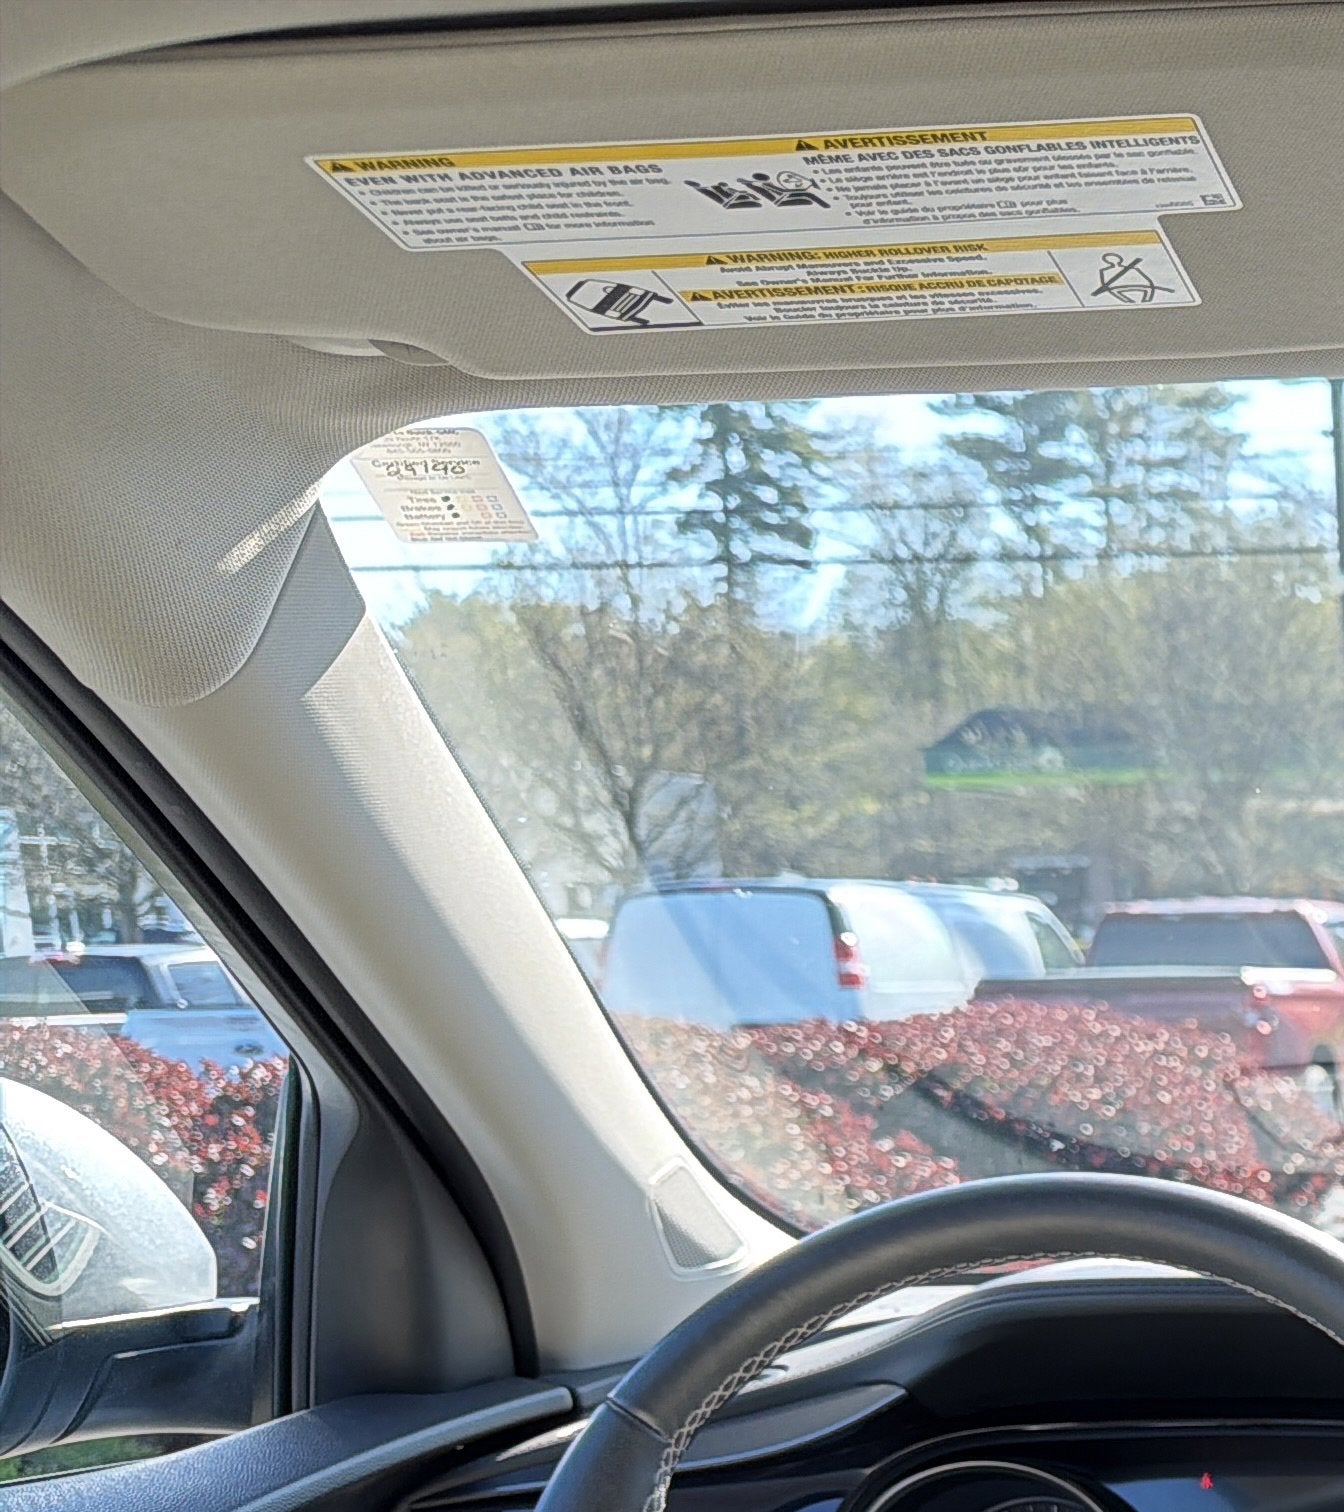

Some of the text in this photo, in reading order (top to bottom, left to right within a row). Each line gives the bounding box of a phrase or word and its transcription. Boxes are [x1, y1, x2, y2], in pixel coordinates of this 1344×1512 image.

[801, 135, 1201, 166] MÊME AVEC DES SACS GONFLABLES INTELLIGENTS
[823, 131, 987, 150] AVERTISSEMENT
[345, 164, 663, 187] EVEN WITH ADVANCED AIR BAGS
[353, 157, 456, 172] WARNING
[726, 243, 987, 264] WARNING: HIGHER ROLLOVER RISK
[712, 275, 1057, 300] AVERTISSEMENT RISQUE ACCRU DE CAPOTAGE
